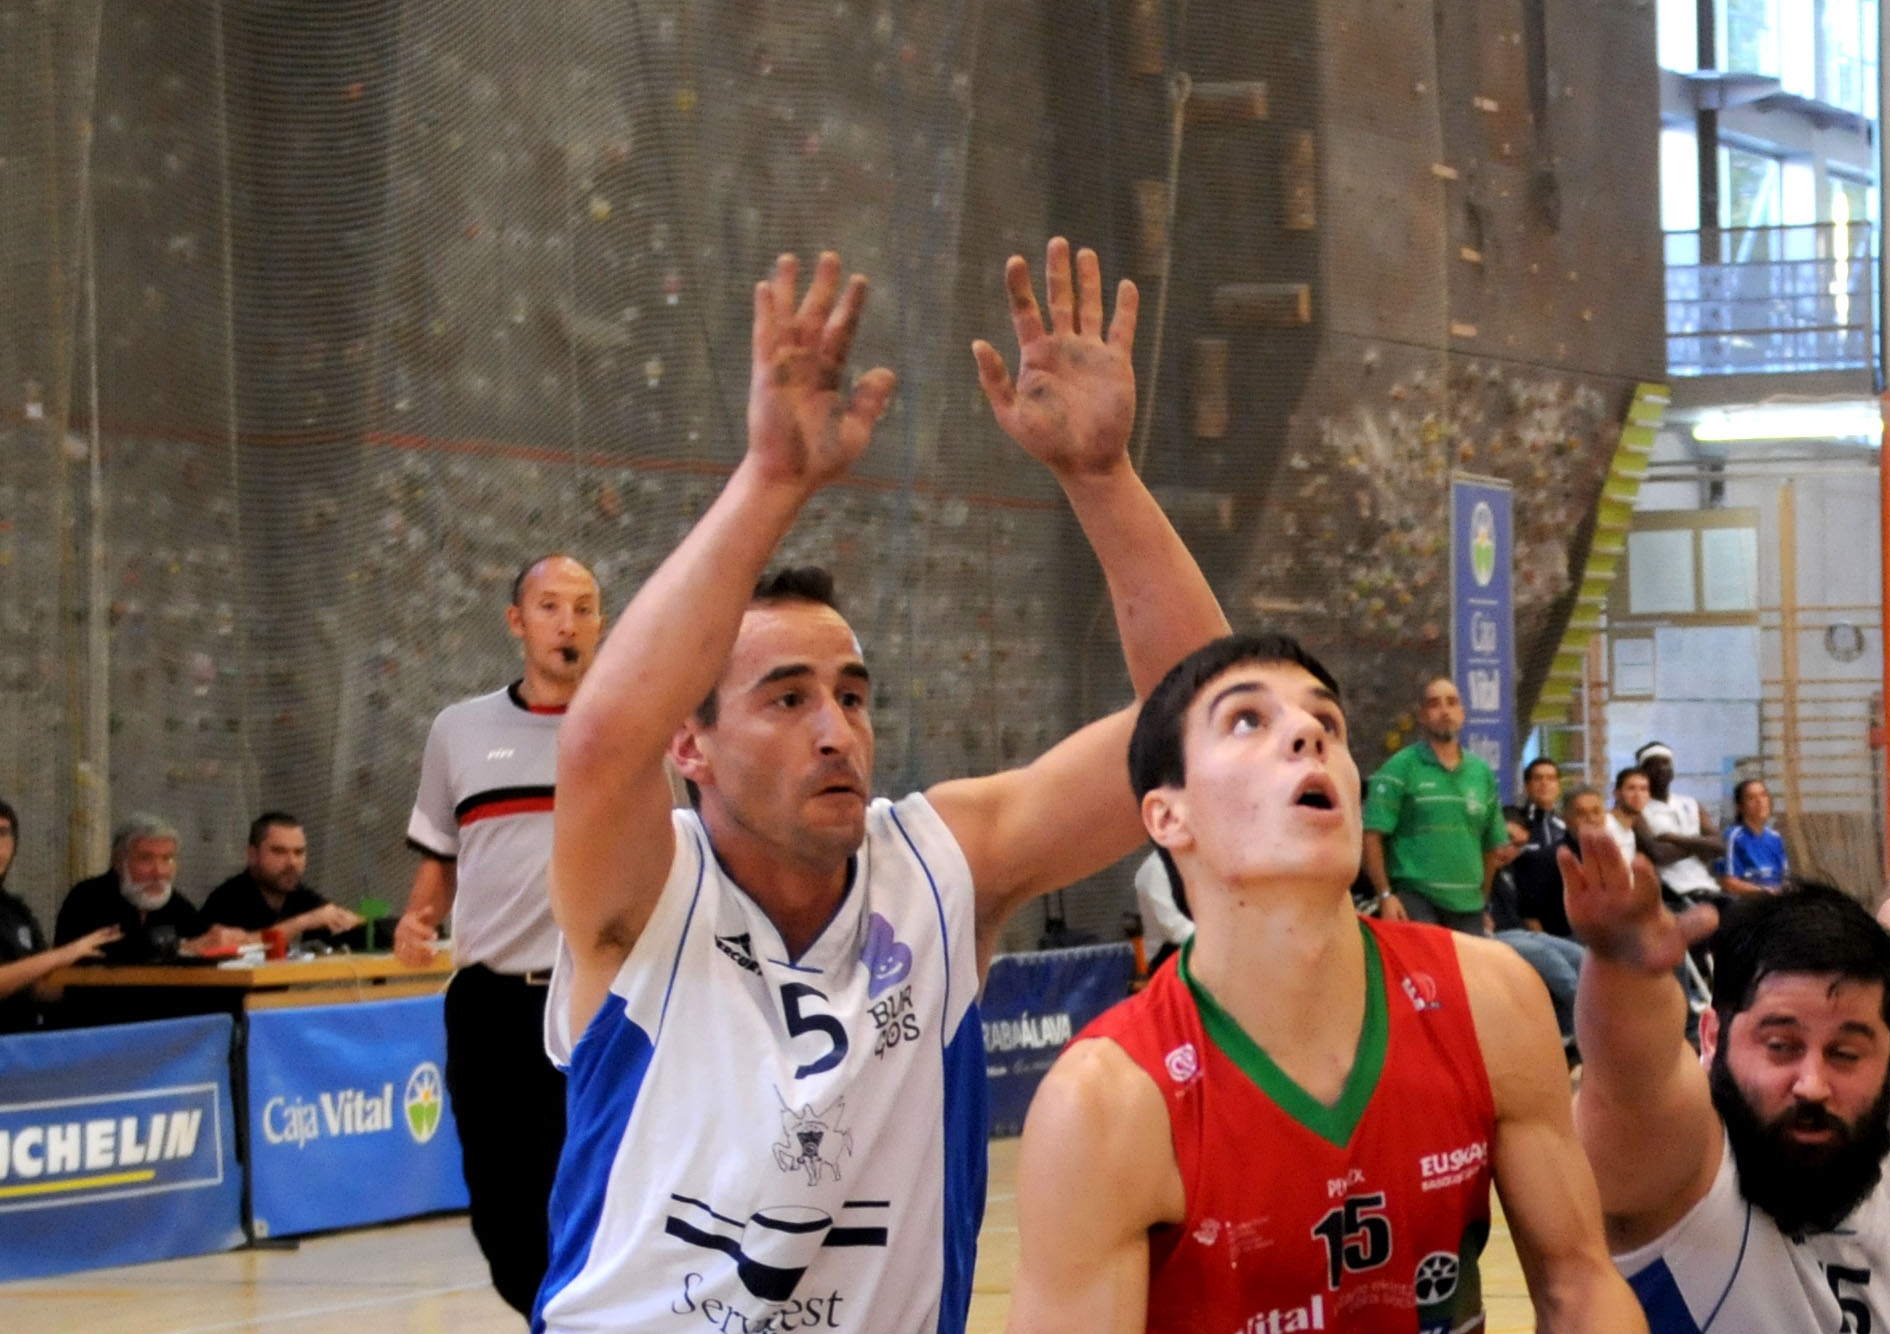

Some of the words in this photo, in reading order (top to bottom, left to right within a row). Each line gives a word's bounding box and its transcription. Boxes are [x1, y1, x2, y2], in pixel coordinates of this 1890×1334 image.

[779, 981, 849, 1080] 5
[319, 1082, 394, 1136] Vital
[1311, 1190, 1394, 1293] 15
